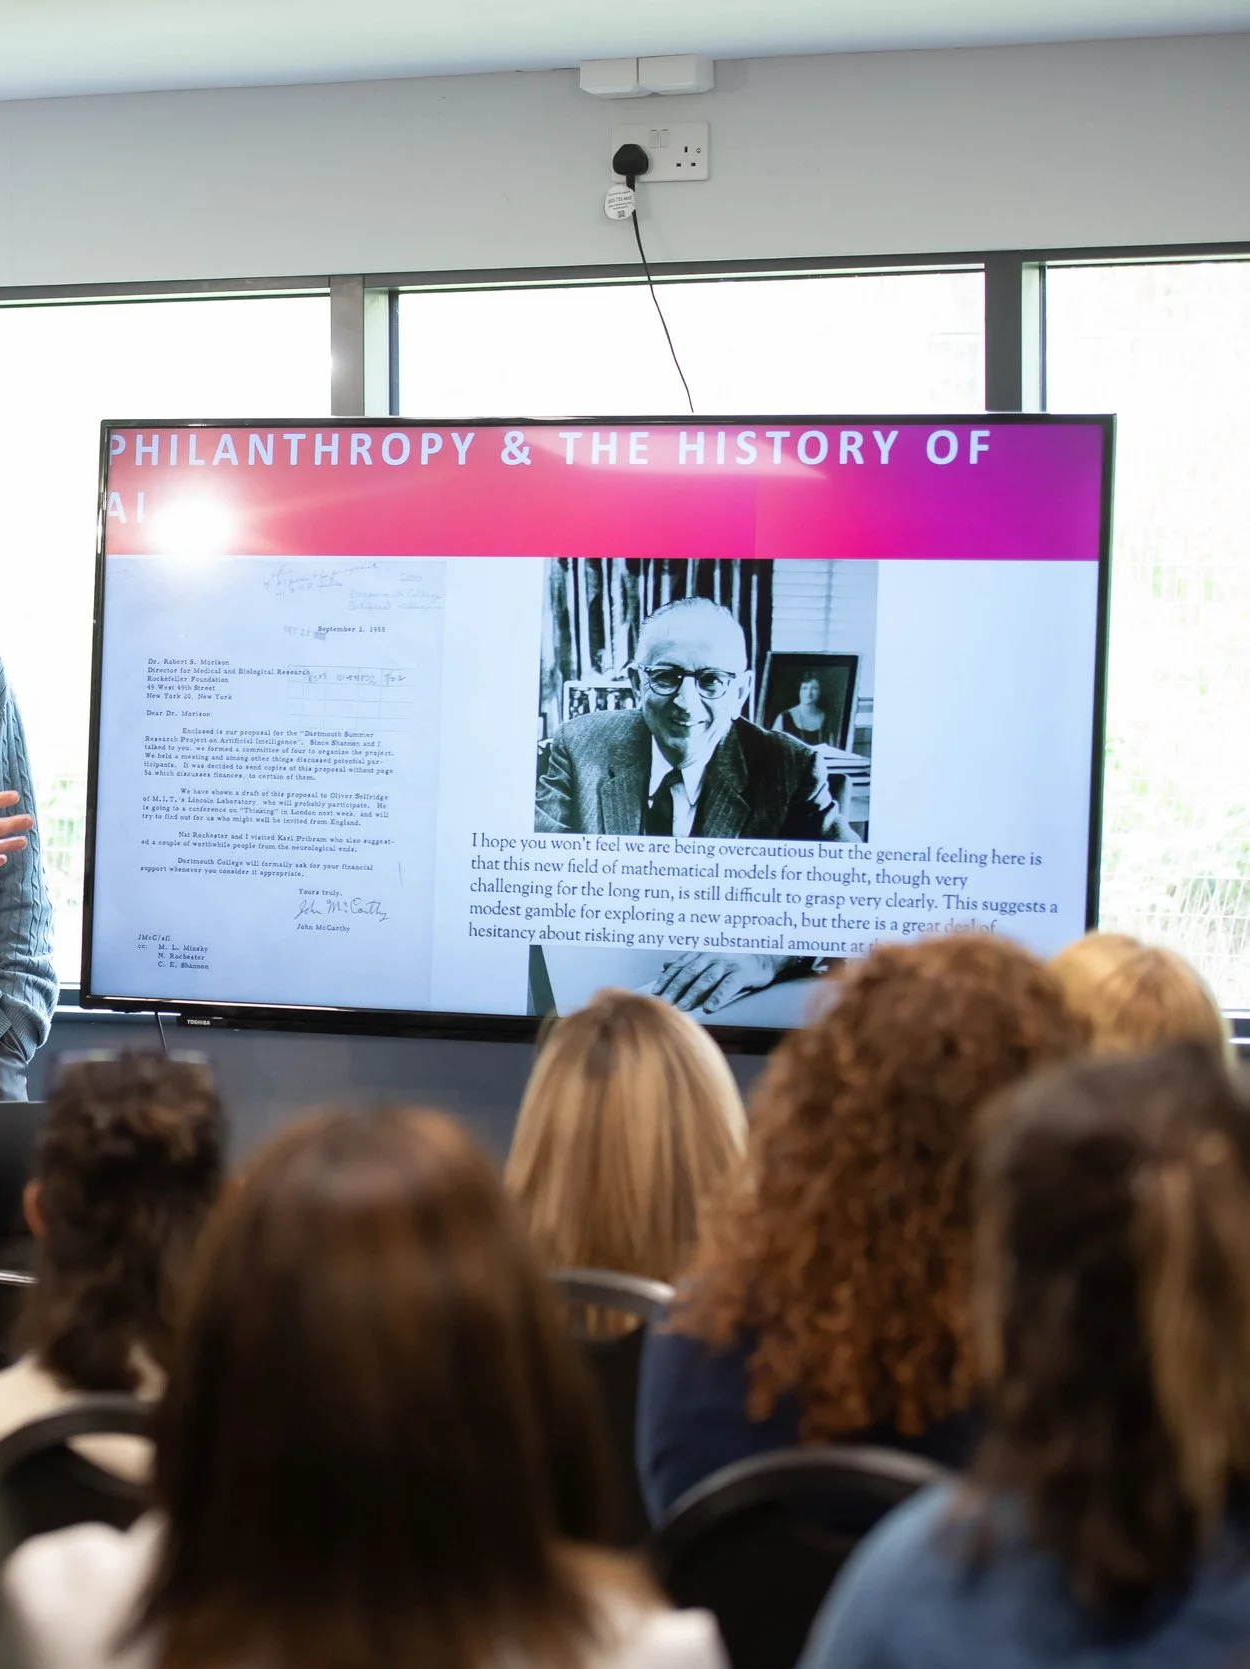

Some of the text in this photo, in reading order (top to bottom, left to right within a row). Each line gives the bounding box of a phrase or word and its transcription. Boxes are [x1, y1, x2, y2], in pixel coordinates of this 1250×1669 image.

[109, 430, 990, 466] PHILANTHROPY & THE HISTORY OF
[108, 492, 144, 524] AI
[317, 626, 356, 634] September
[238, 668, 274, 677] Biological
[239, 729, 270, 738] proposal
[286, 792, 318, 800] proposal
[354, 793, 388, 802] Selfridge
[472, 832, 1042, 869] I hope you won’t feel we are being overcautious but the general feeling here is
[177, 857, 214, 865] Dartmouth
[216, 858, 243, 868] College
[261, 860, 292, 870] formally
[470, 854, 968, 891] that this new field of mathematical models for thought, though very
[469, 877, 1058, 917] challenging for the long run, is still difficult to grasp very clearly. This suggests a
[469, 900, 521, 916] modest
[524, 902, 576, 921] gamble
[580, 903, 601, 919] for
[604, 905, 674, 927] exploring
[677, 912, 686, 923] a
[690, 913, 720, 924] new
[724, 911, 797, 930] approach,
[801, 912, 827, 928] but
[831, 913, 870, 930] there
[874, 915, 886, 930] is
[890, 920, 898, 931] a
[902, 920, 938, 936] great
[980, 919, 997, 935] of
[315, 924, 350, 934] McCarthy
[468, 921, 536, 944] hesitancy
[538, 924, 580, 941] about
[584, 926, 634, 948] risking
[638, 933, 664, 949] any
[668, 935, 699, 950] very
[703, 932, 783, 949] substantial
[787, 939, 846, 952] amount
[850, 940, 863, 952] at
[183, 944, 208, 954] Minsky
[169, 953, 205, 961] Rochester
[180, 962, 209, 970] Shannon
